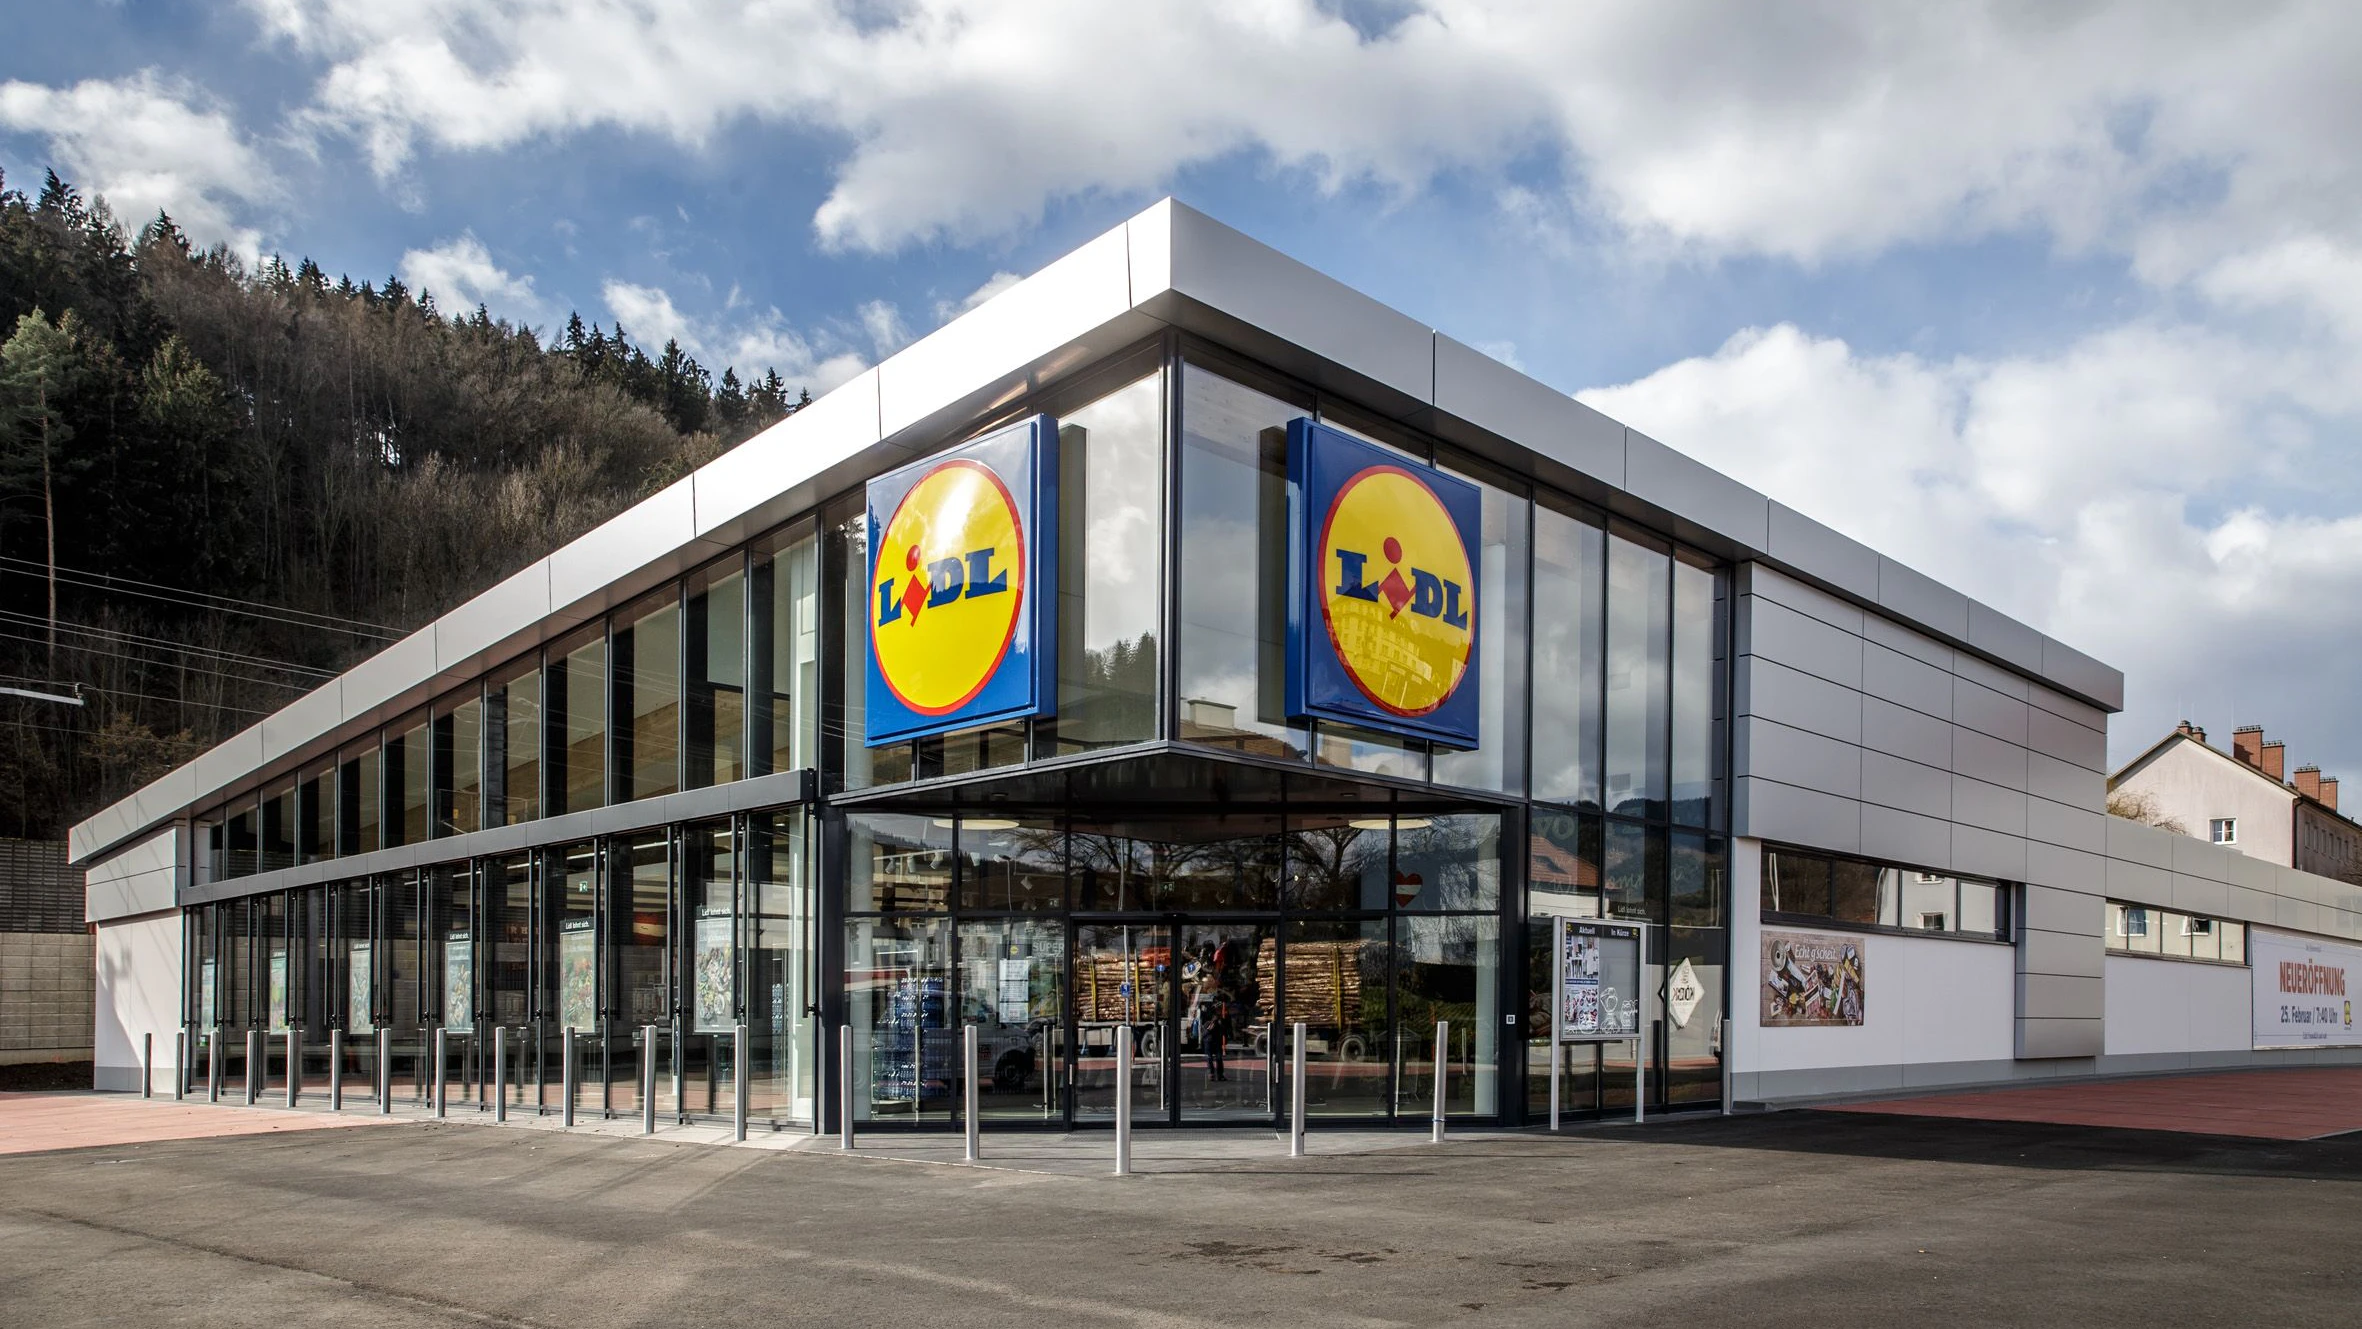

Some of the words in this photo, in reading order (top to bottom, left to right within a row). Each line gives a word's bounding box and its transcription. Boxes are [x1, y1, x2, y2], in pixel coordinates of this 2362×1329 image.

[1579, 926, 1596, 935] Aktuell
[1611, 928, 1616, 936] In
[1616, 928, 1630, 937] Kürze
[1794, 944, 1810, 958] Echt
[2279, 958, 2346, 997] NEUERÖFFNUNG
[2280, 1005, 2290, 1024] 25.
[2291, 1005, 2312, 1024] Februar
[2328, 1007, 2338, 1024] Uhr
